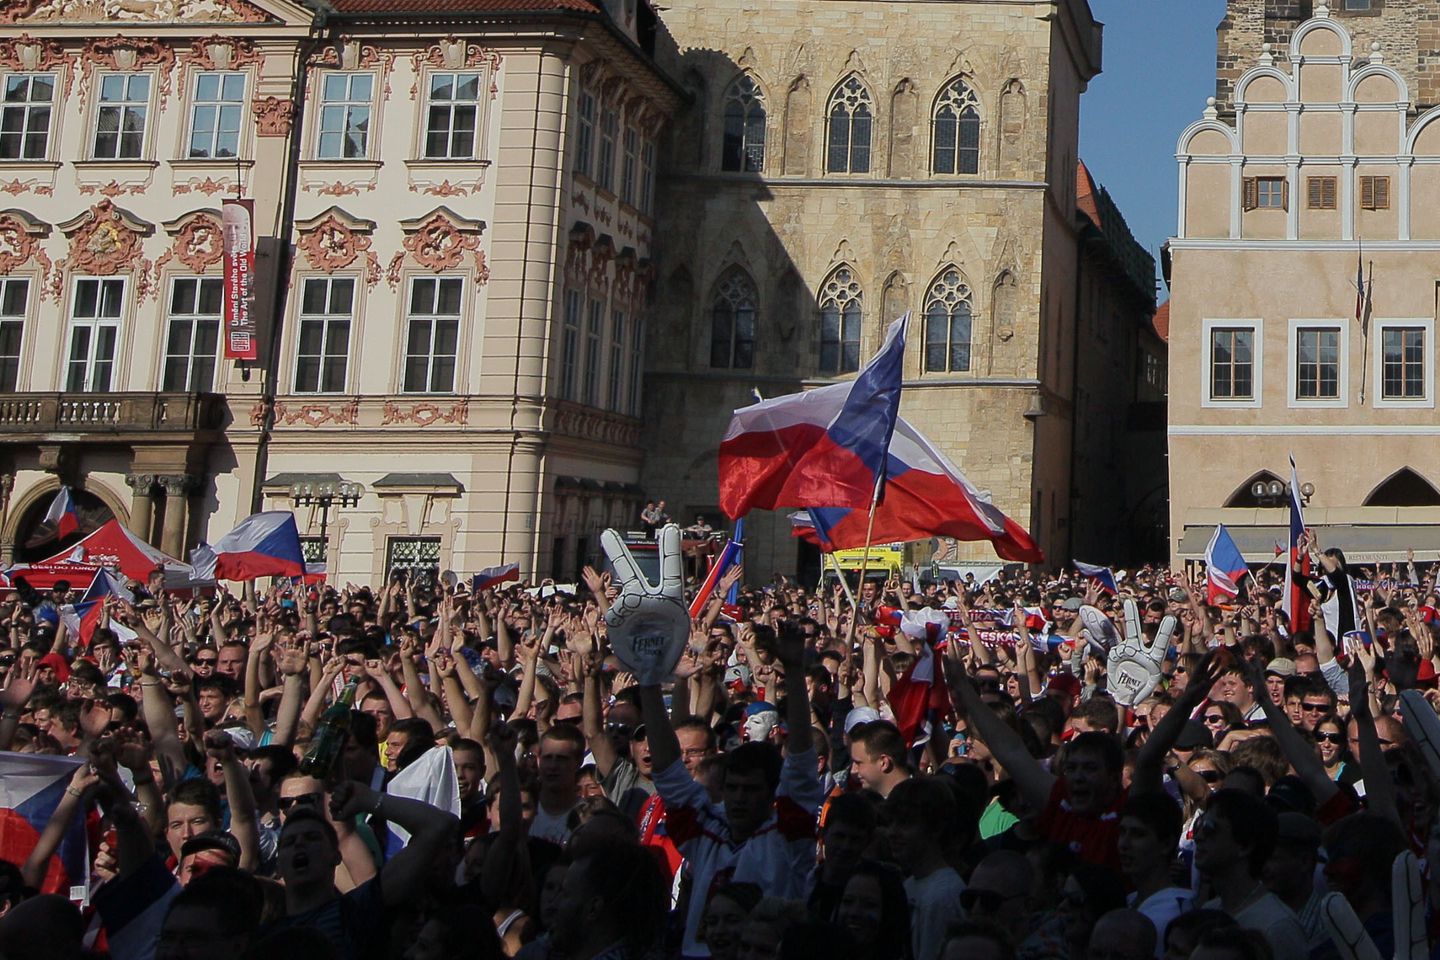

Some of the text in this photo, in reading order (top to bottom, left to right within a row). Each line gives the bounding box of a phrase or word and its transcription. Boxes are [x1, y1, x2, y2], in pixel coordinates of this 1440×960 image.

[239, 258, 248, 271] Old
[231, 268, 239, 300] Starého
[240, 273, 248, 285] the
[241, 286, 248, 295] of
[241, 296, 249, 308] Art
[231, 301, 239, 327] Umění
[240, 310, 249, 326] The
